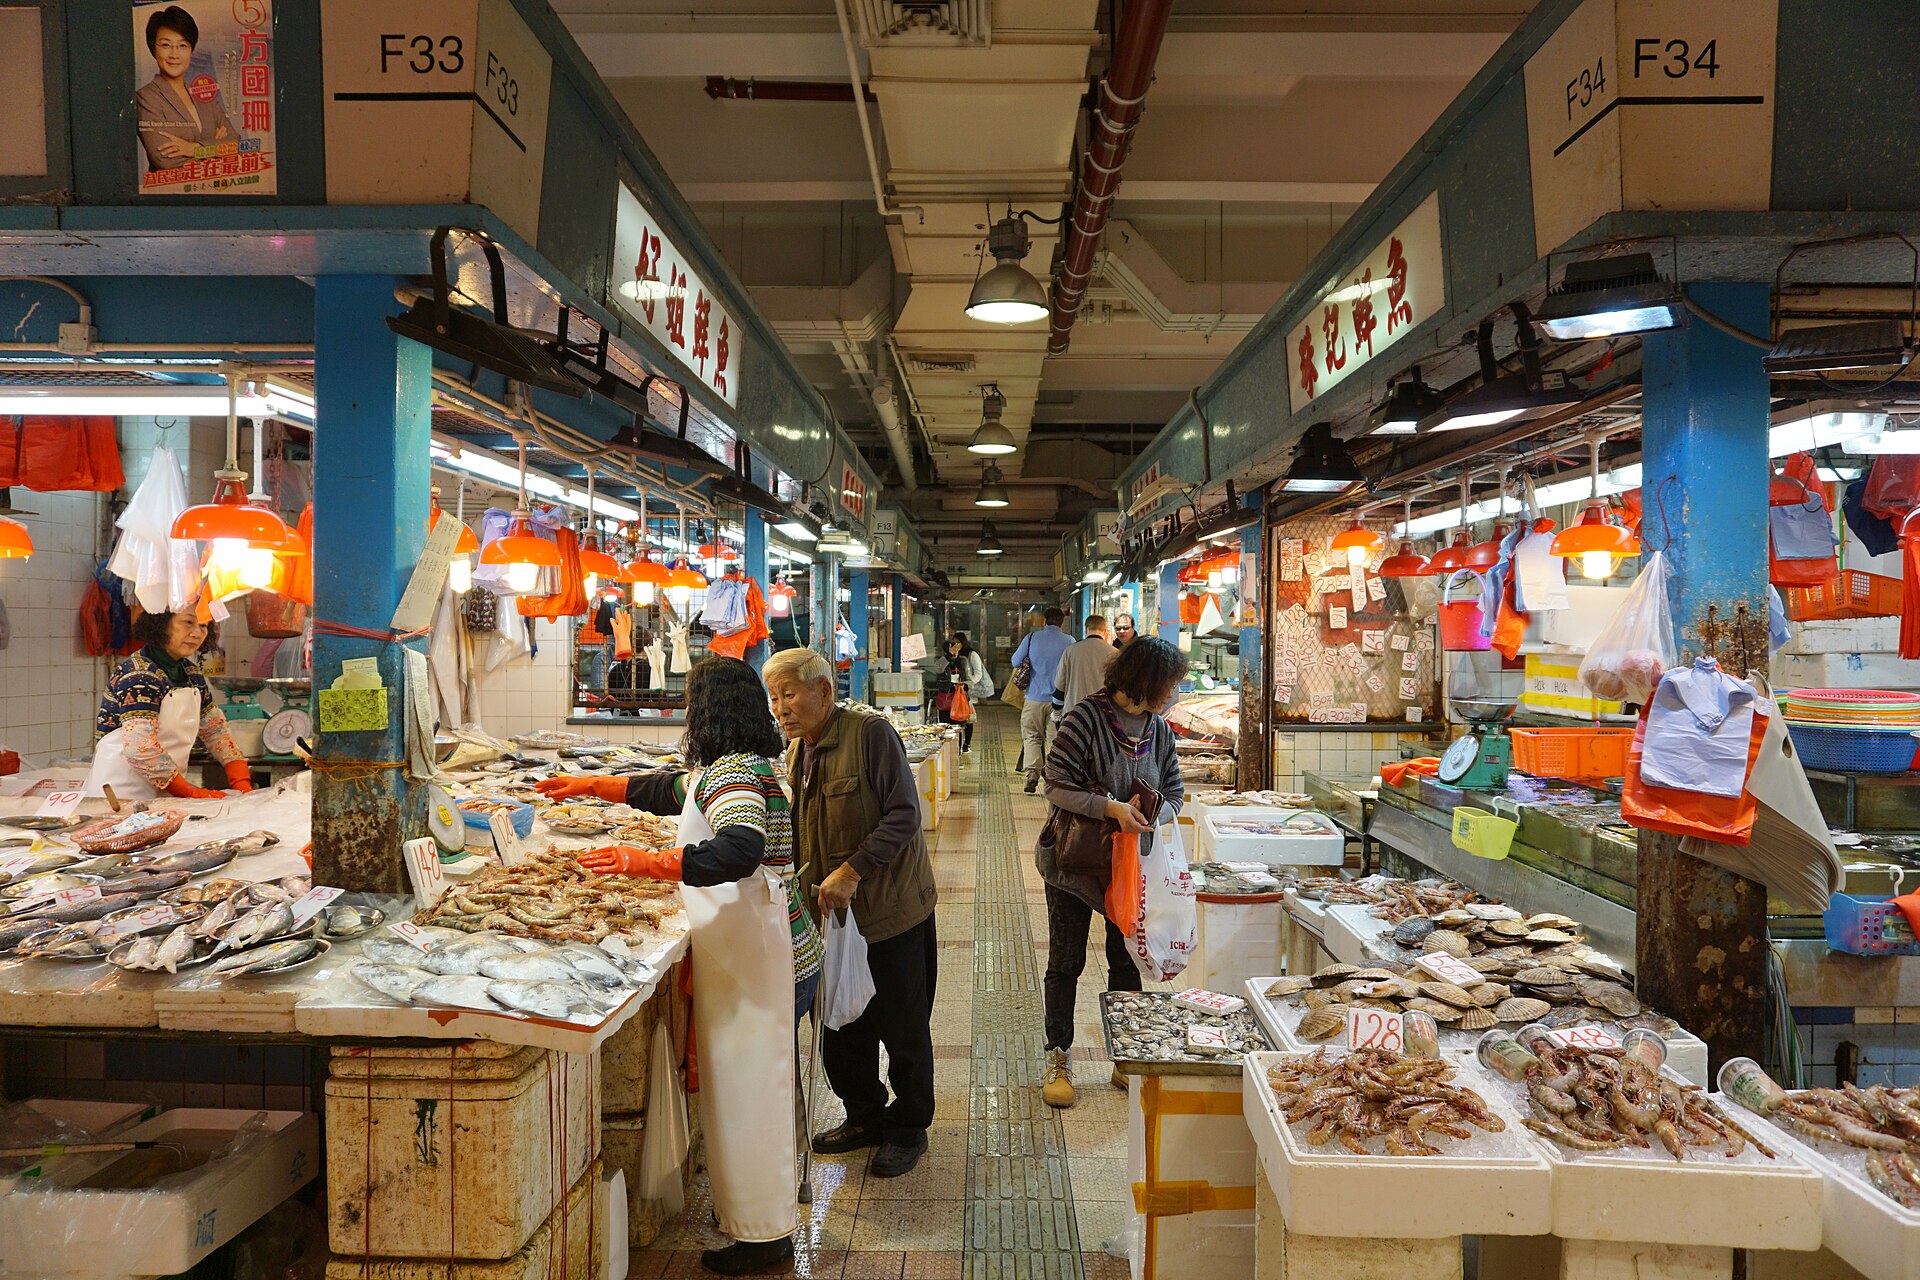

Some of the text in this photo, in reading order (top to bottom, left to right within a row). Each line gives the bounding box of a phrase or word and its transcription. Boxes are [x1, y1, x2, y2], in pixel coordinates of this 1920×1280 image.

[381, 34, 464, 74] F33
[1633, 38, 1721, 79] F34
[239, 29, 271, 133] 方國珊
[485, 49, 519, 117] F33
[1566, 56, 1606, 121] F34
[634, 225, 729, 398] 好姐鮮魚
[877, 522, 892, 530] F13
[1316, 579, 1336, 592] 28
[1285, 603, 1306, 627] 128
[1324, 648, 1336, 667] 100
[1404, 653, 1417, 669] 48
[49, 793, 79, 807] 90
[413, 841, 441, 888] 148
[307, 888, 335, 901] 45
[1353, 1013, 1401, 1051] 128
[1555, 1028, 1617, 1048] 148
